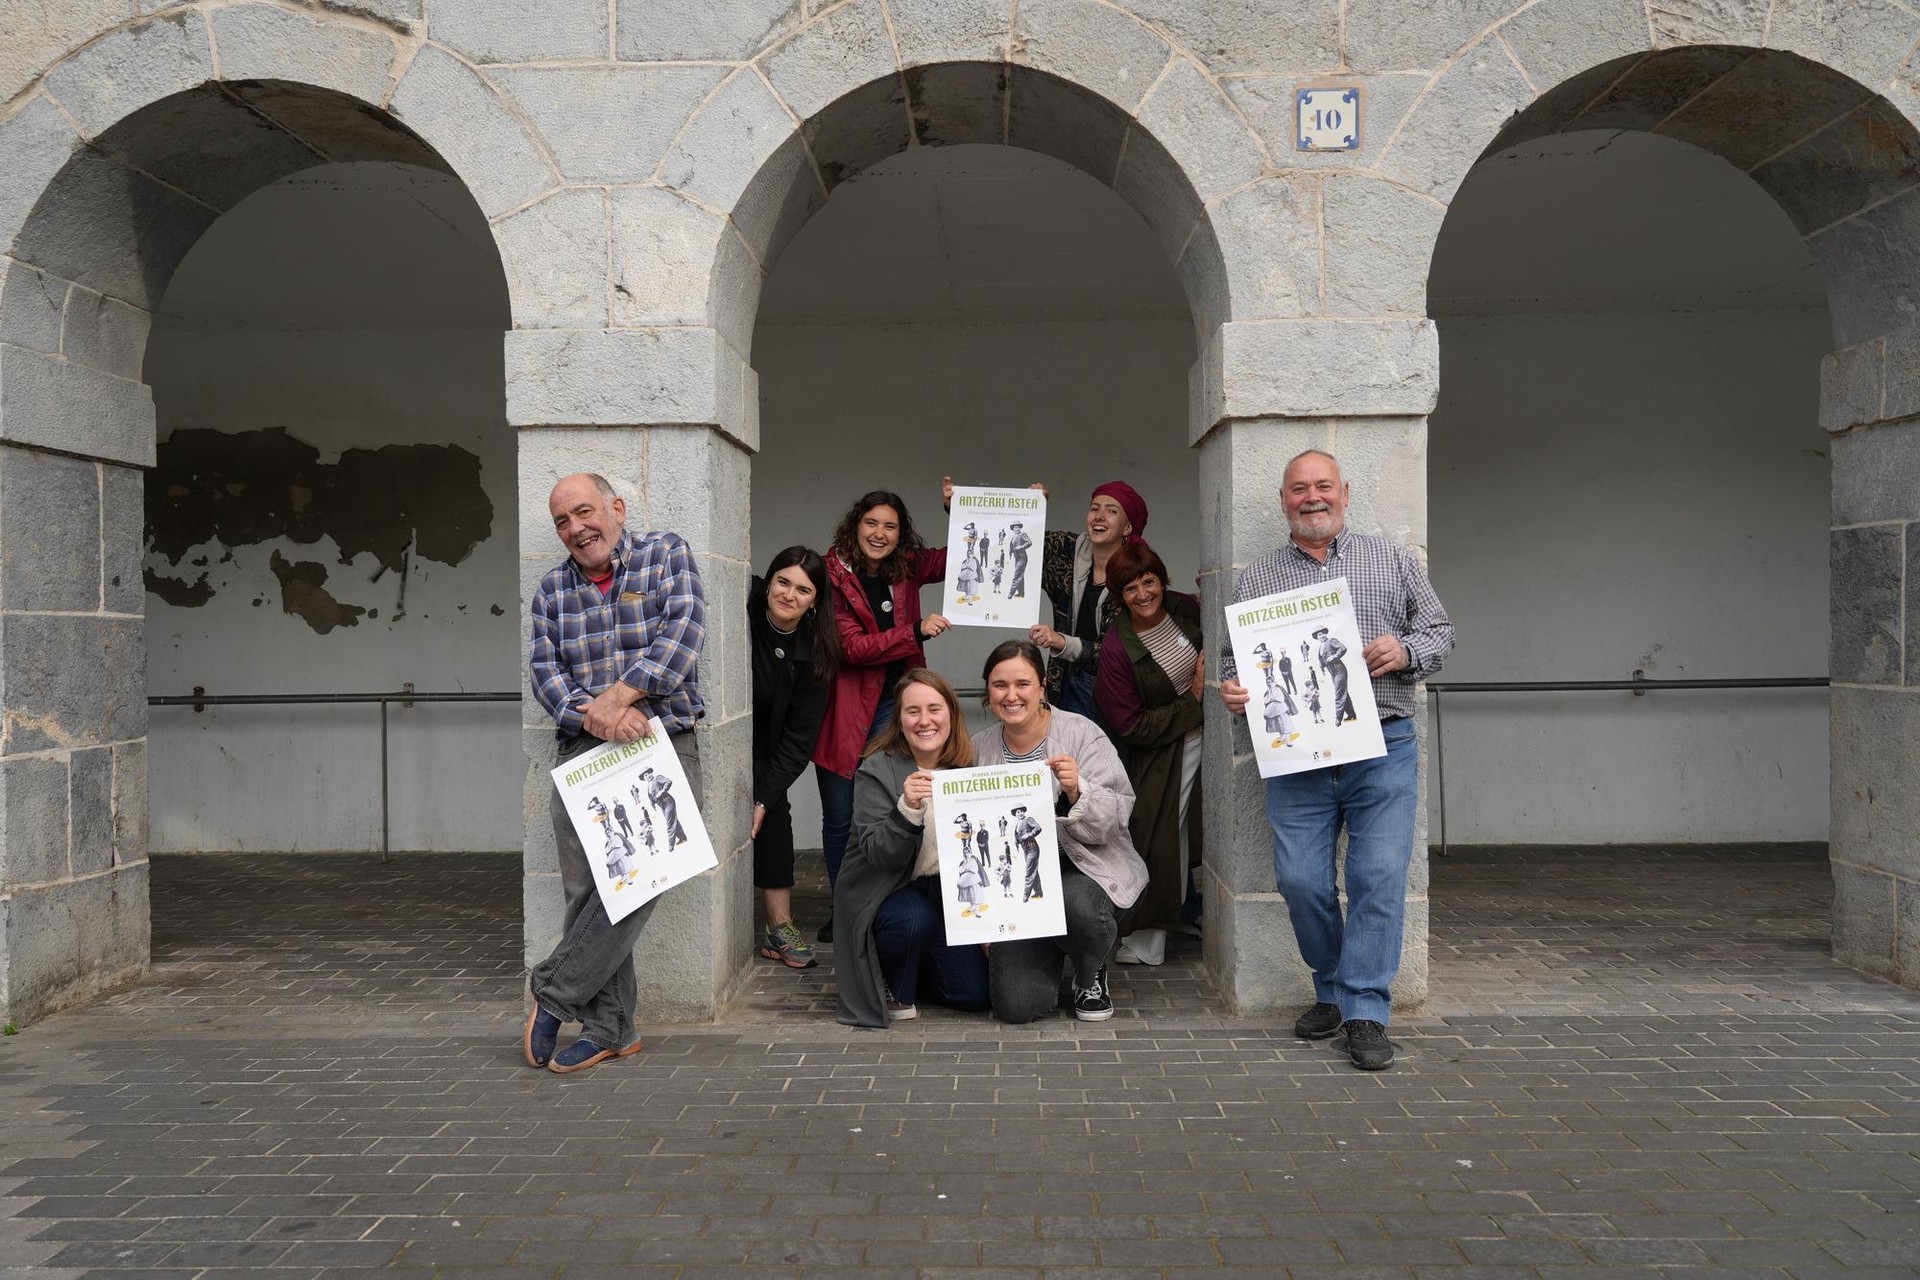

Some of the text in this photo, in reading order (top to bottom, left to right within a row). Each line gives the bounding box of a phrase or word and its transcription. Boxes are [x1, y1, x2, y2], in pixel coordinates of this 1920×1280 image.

[1316, 109, 1342, 131] 10
[959, 496, 1038, 509] ANTZERKI ASTEA
[1238, 602, 1298, 627] ANTZERKI
[1301, 592, 1340, 613] ASTEA
[565, 750, 621, 787] ANTZERKI
[942, 779, 1001, 795] ANTZERKI
[1004, 773, 1041, 789] ASTEA
